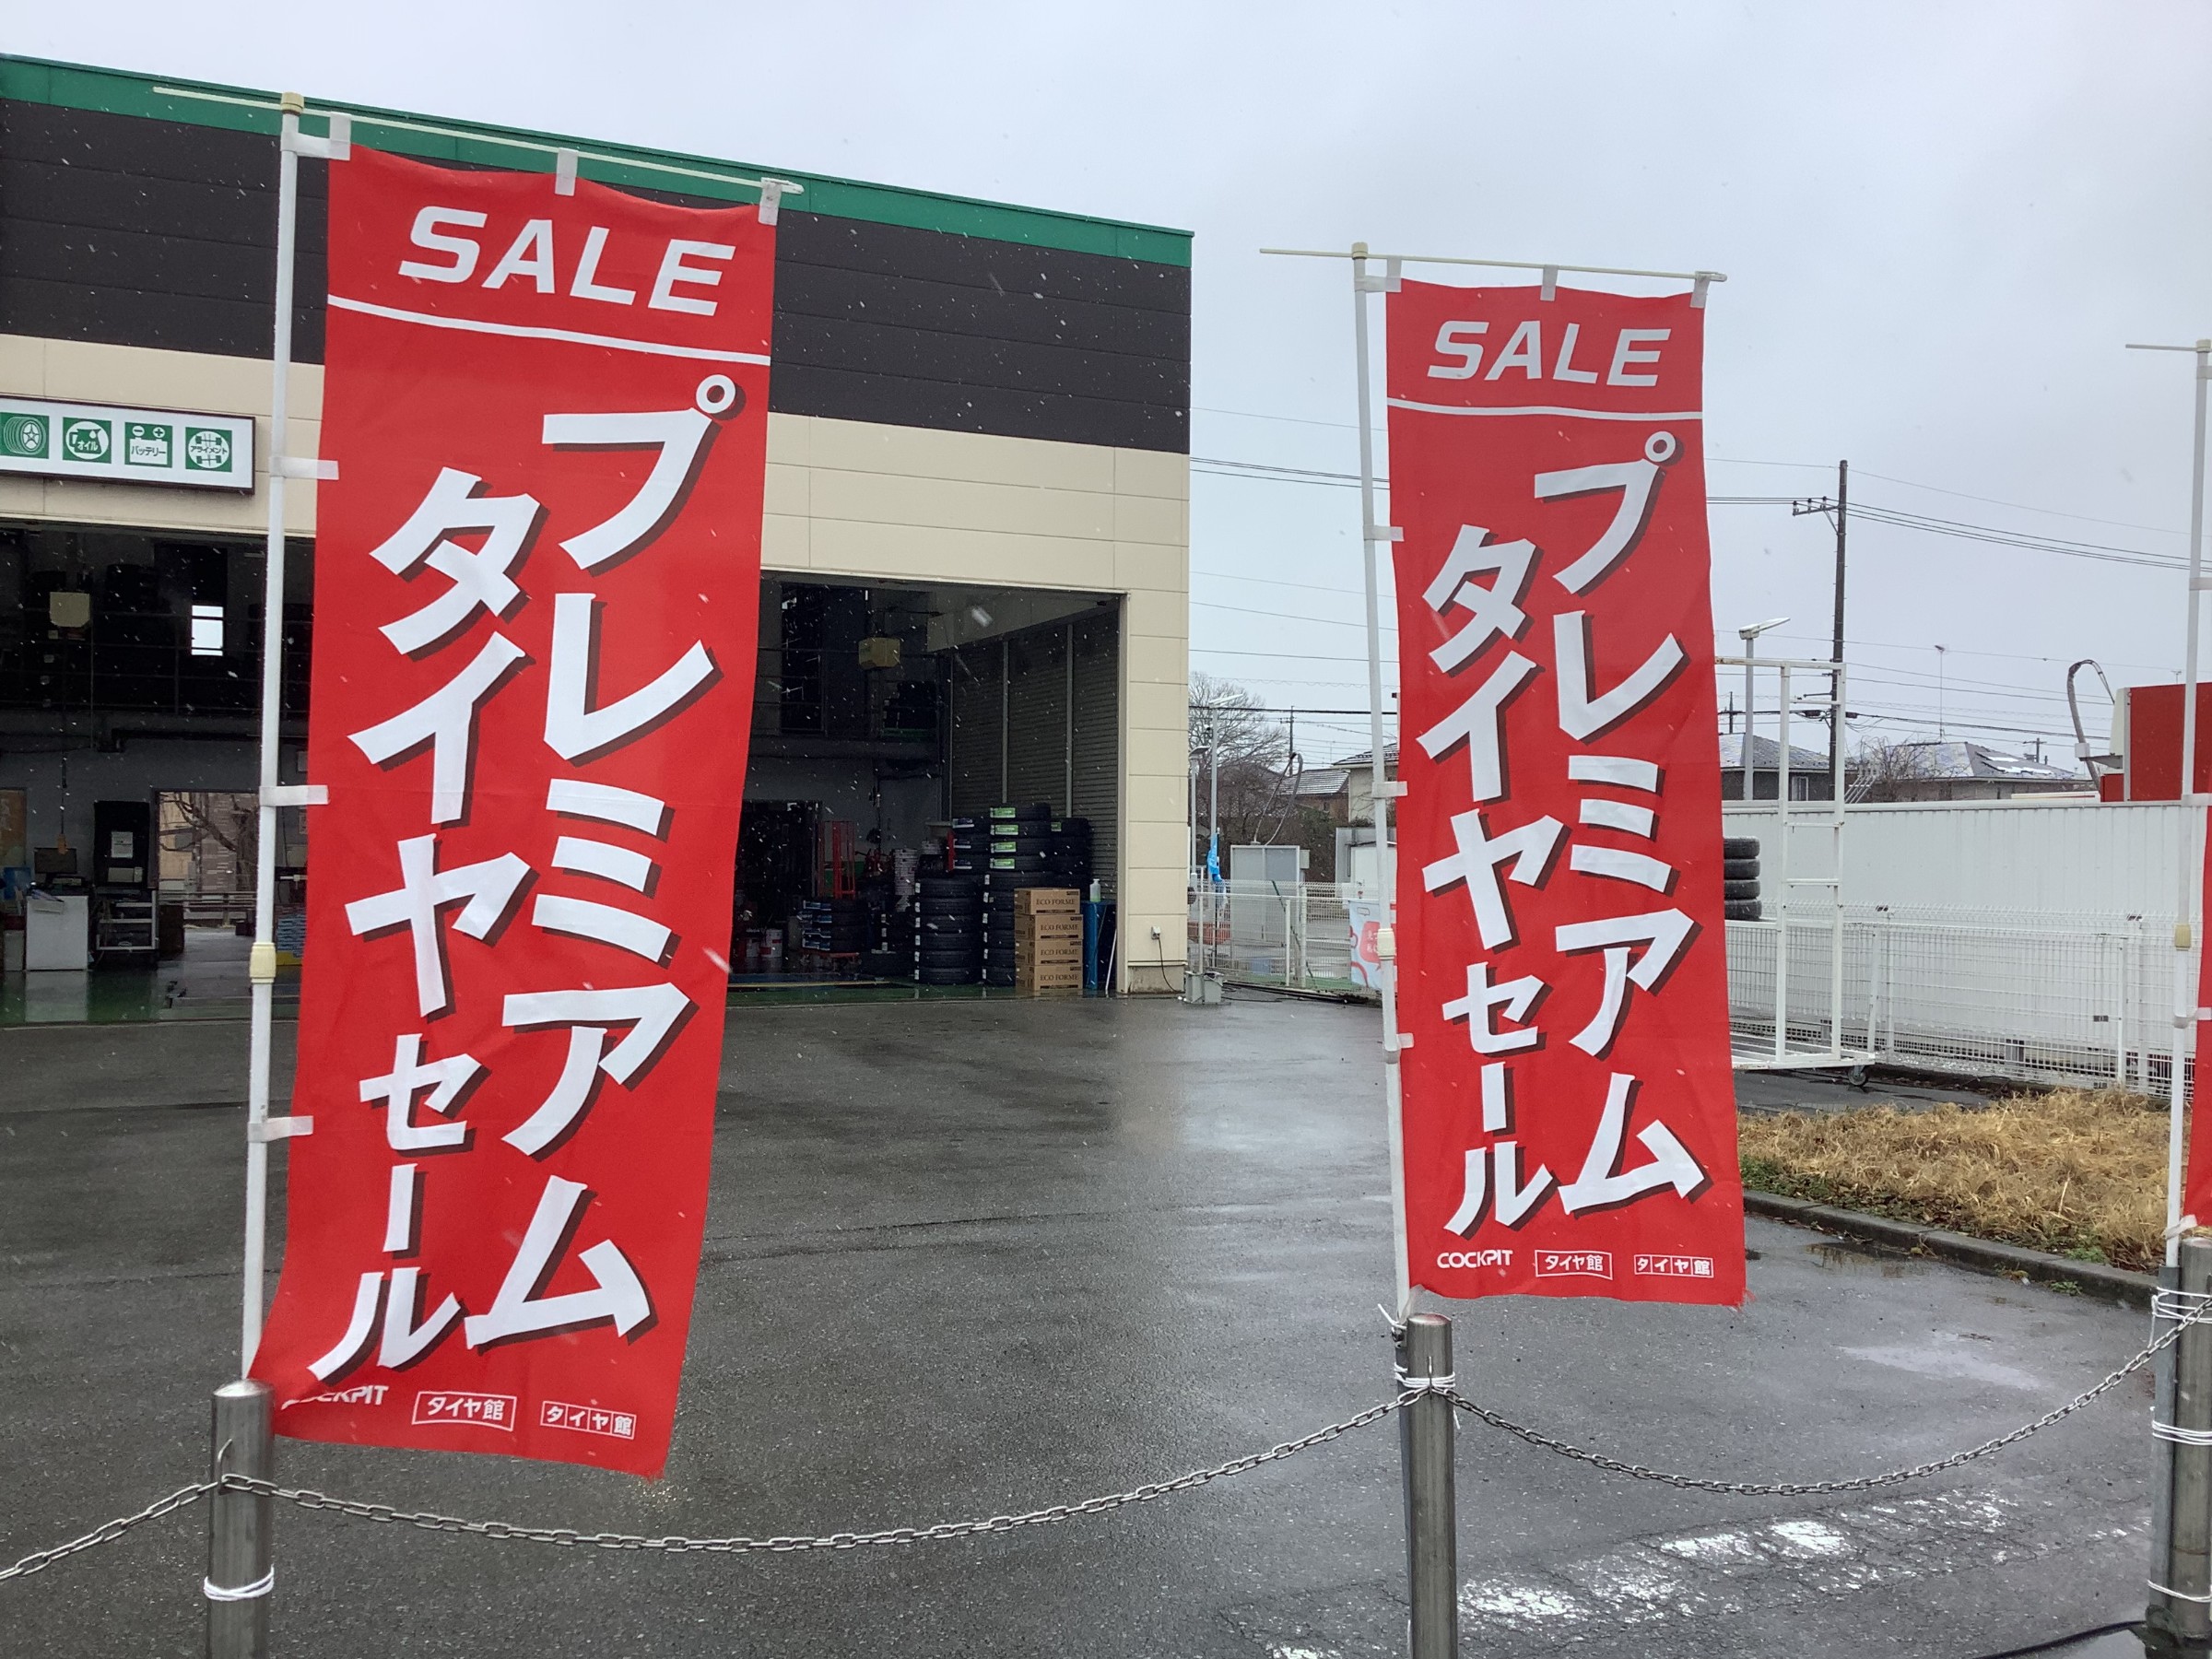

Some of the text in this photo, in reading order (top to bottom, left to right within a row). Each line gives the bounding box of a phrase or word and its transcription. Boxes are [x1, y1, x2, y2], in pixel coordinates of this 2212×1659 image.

[397, 205, 736, 317] SALE
[1427, 320, 1672, 387] SALE
[76, 440, 99, 452] オイル
[131, 444, 167, 458] バッテリー
[190, 444, 229, 456] アライメント
[1535, 430, 1707, 1216] プレミアム
[464, 374, 738, 1351] プレミアム
[1416, 524, 1565, 1237] タイヤセール
[307, 466, 542, 1382] タイヤセール
[1436, 1249, 1513, 1269] COCKPIT
[1544, 1253, 1604, 1272] タイヤ館
[1636, 1256, 1712, 1277] タイヤ館
[427, 1396, 505, 1422] タイヤ館
[546, 1404, 634, 1437] タイヤ館
